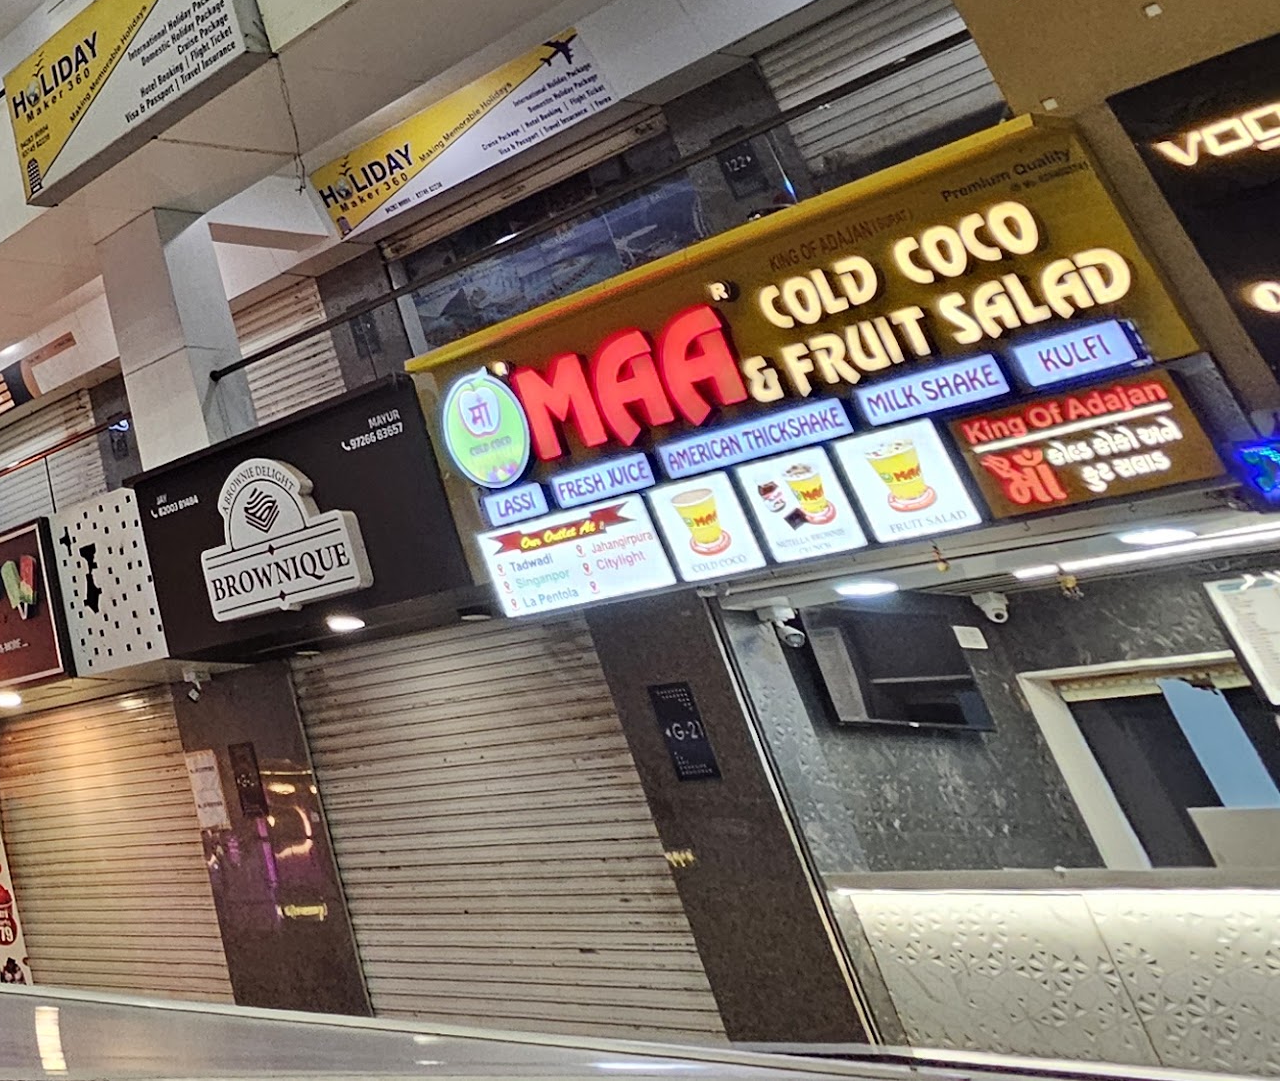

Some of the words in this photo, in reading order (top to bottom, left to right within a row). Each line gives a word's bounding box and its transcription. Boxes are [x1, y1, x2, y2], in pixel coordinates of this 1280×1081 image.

[128, 25, 168, 61] International
[168, 7, 191, 32] Holiday
[141, 41, 170, 66] Domestic
[171, 22, 195, 44] Holiday
[195, 0, 225, 26] Package
[177, 36, 197, 55] Cruise
[199, 14, 228, 39] Package
[12, 31, 99, 118] HOLIDAY
[27, 91, 63, 123] Maker
[67, 69, 90, 92] 360
[319, 142, 412, 208] HOLIDAY
[341, 188, 380, 212] Maker
[385, 172, 407, 191] 360
[942, 171, 1010, 202] Premium
[1014, 148, 1072, 176] Quality
[759, 255, 878, 329] COLD
[893, 200, 1039, 285] COCO
[744, 356, 784, 403] &
[780, 305, 932, 397] FRUIT
[938, 247, 1131, 345] SALAD
[1039, 334, 1111, 372] KULFI
[511, 303, 748, 462] MAA
[866, 386, 915, 417] MILK
[921, 364, 999, 402] SHAKE
[368, 409, 401, 428] MAYUR
[961, 415, 1026, 445] King
[1027, 401, 1064, 427] Of
[1066, 379, 1168, 419] Adajan
[668, 433, 741, 471] AMERICAN
[742, 406, 845, 451] THICKSHAKE
[224, 466, 254, 504] BROWNIE
[255, 465, 295, 490] DELIGHT
[497, 492, 536, 519] LASSI
[558, 473, 606, 500] FRESH
[610, 464, 649, 490] JUICE
[521, 535, 540, 549] Our
[543, 526, 576, 543] Outlet
[591, 531, 654, 555] Jahangirpura
[596, 550, 646, 572] Citylight
[211, 542, 350, 601] BROWNIQUE
[510, 553, 553, 573] Tadwadi
[515, 569, 570, 590] Singanpor
[522, 597, 538, 609] La
[539, 587, 579, 605] Pentola
